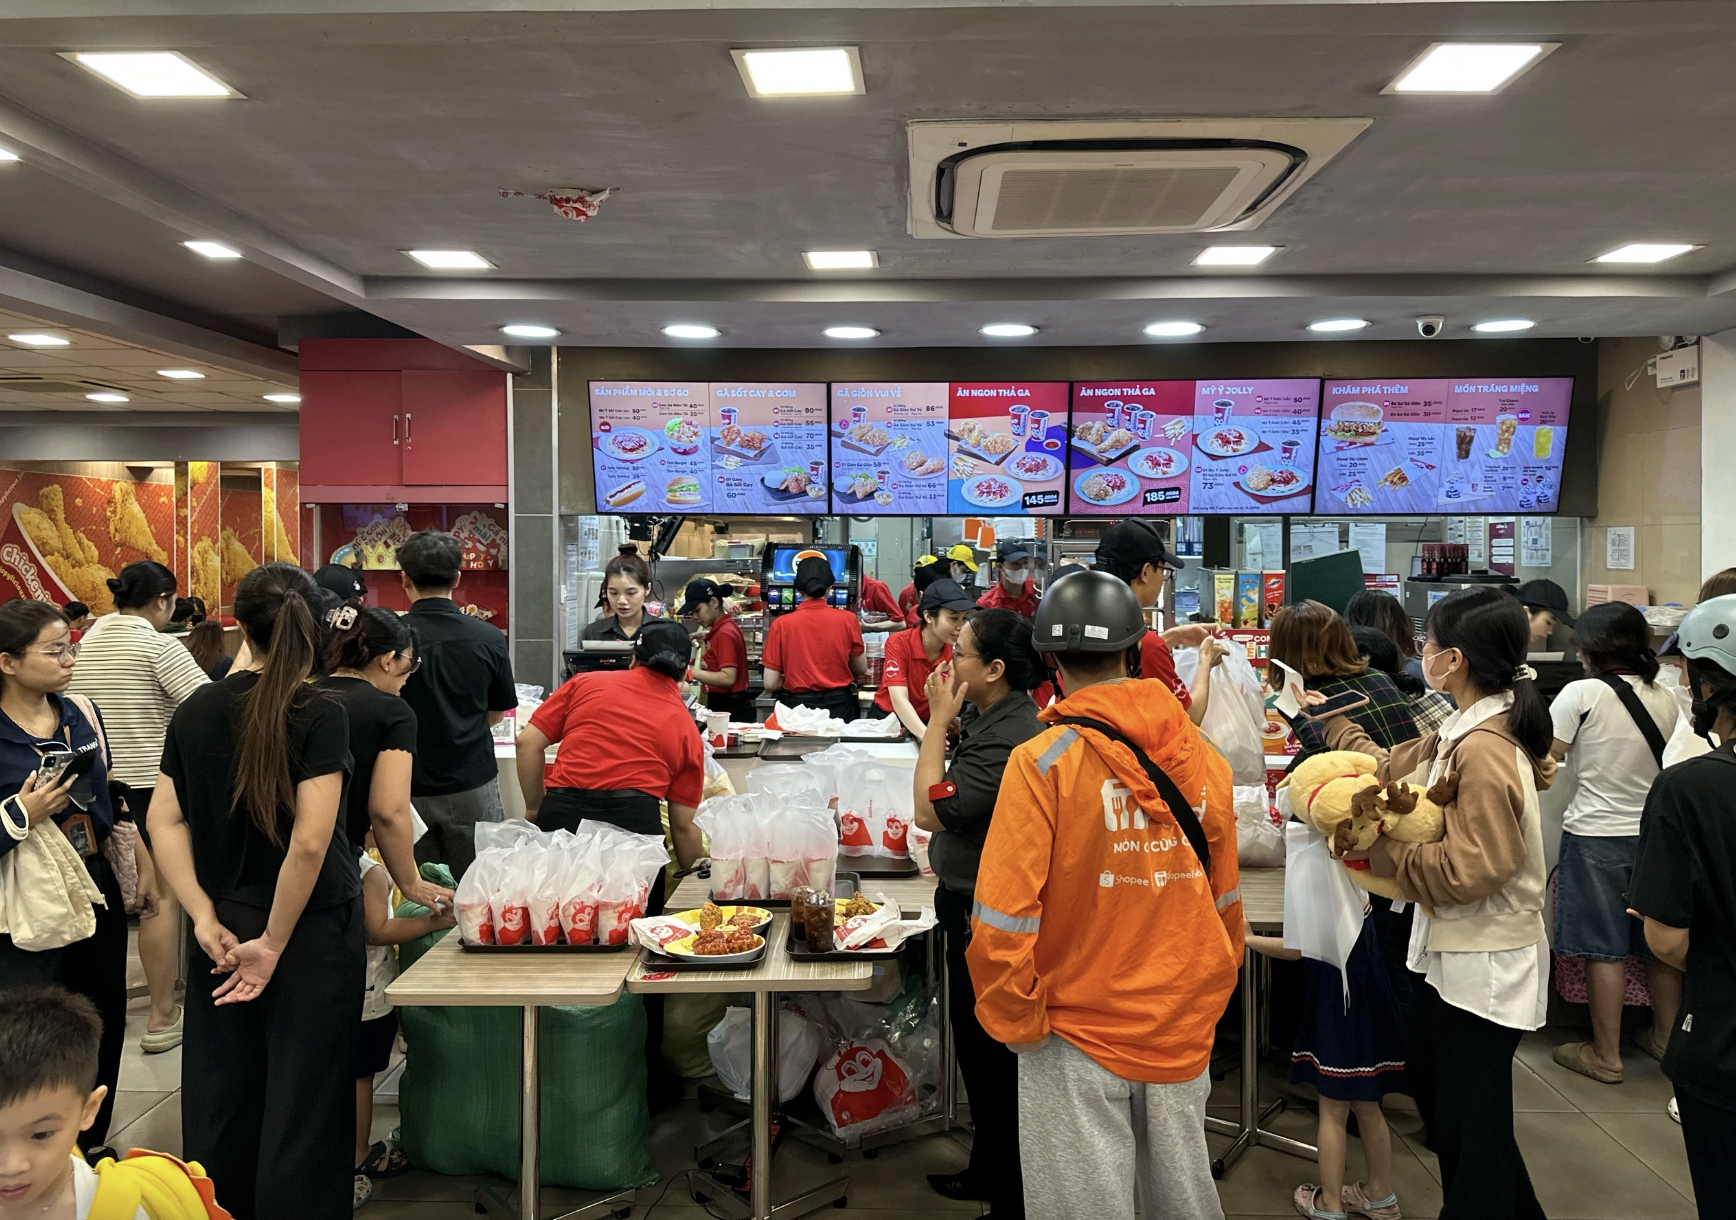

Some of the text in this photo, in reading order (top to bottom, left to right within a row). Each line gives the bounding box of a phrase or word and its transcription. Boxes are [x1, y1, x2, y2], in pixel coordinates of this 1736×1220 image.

[594, 386, 612, 396] SẢN
[613, 386, 637, 396] PHẨM
[716, 388, 730, 397] GÀ
[731, 388, 748, 397] SỐT
[776, 389, 796, 397] CƠM
[837, 388, 850, 397] GÀ
[851, 388, 872, 397] GIÒN
[890, 386, 902, 397] VẺ
[956, 388, 970, 396] ĂN
[998, 386, 1016, 396] THẢ
[1080, 387, 1093, 396] ĂN
[1122, 385, 1141, 396] THẢ
[1226, 386, 1254, 394] JOLLY
[1332, 384, 1408, 394] KHÁM PHÁ THÊM
[1454, 384, 1539, 394] MÓN TRÁNG MIỆNG
[1114, 838, 1140, 854] MÓN
[1115, 874, 1150, 886] Shopee
